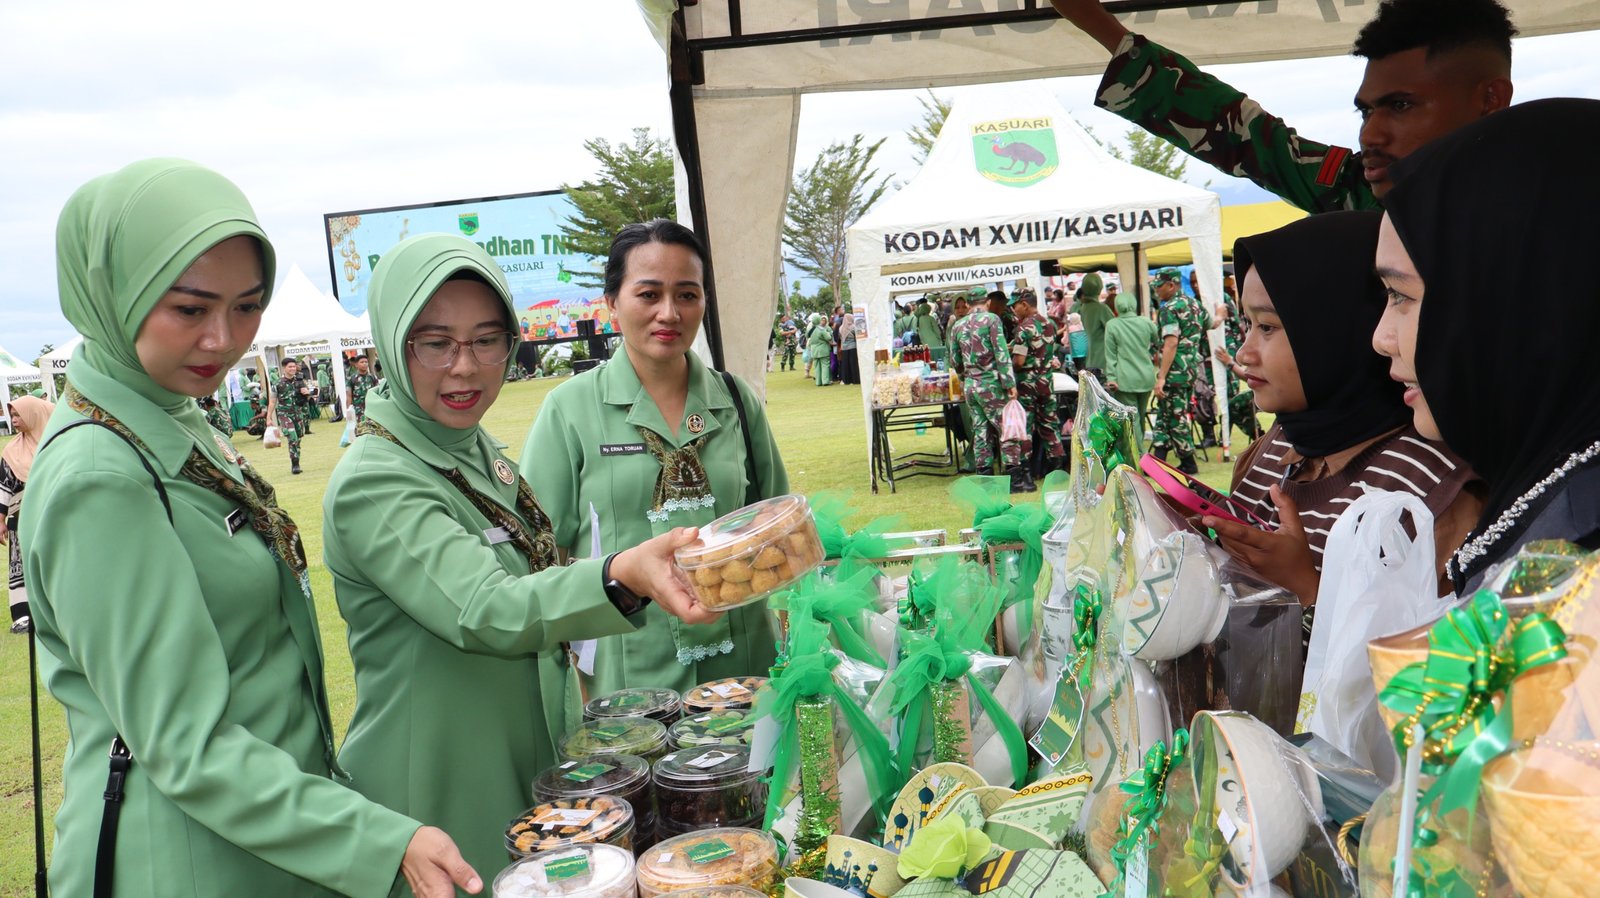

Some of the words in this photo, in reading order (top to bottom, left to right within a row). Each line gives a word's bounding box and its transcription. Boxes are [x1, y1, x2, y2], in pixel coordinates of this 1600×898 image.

[974, 118, 1049, 134] KASUARI
[884, 226, 981, 254] KODAM
[988, 205, 1184, 246] XVIII/KASUARI
[890, 273, 934, 287] KODAM
[937, 264, 1024, 283] XVIII/KASUARI
[286, 346, 310, 355] KODAM
